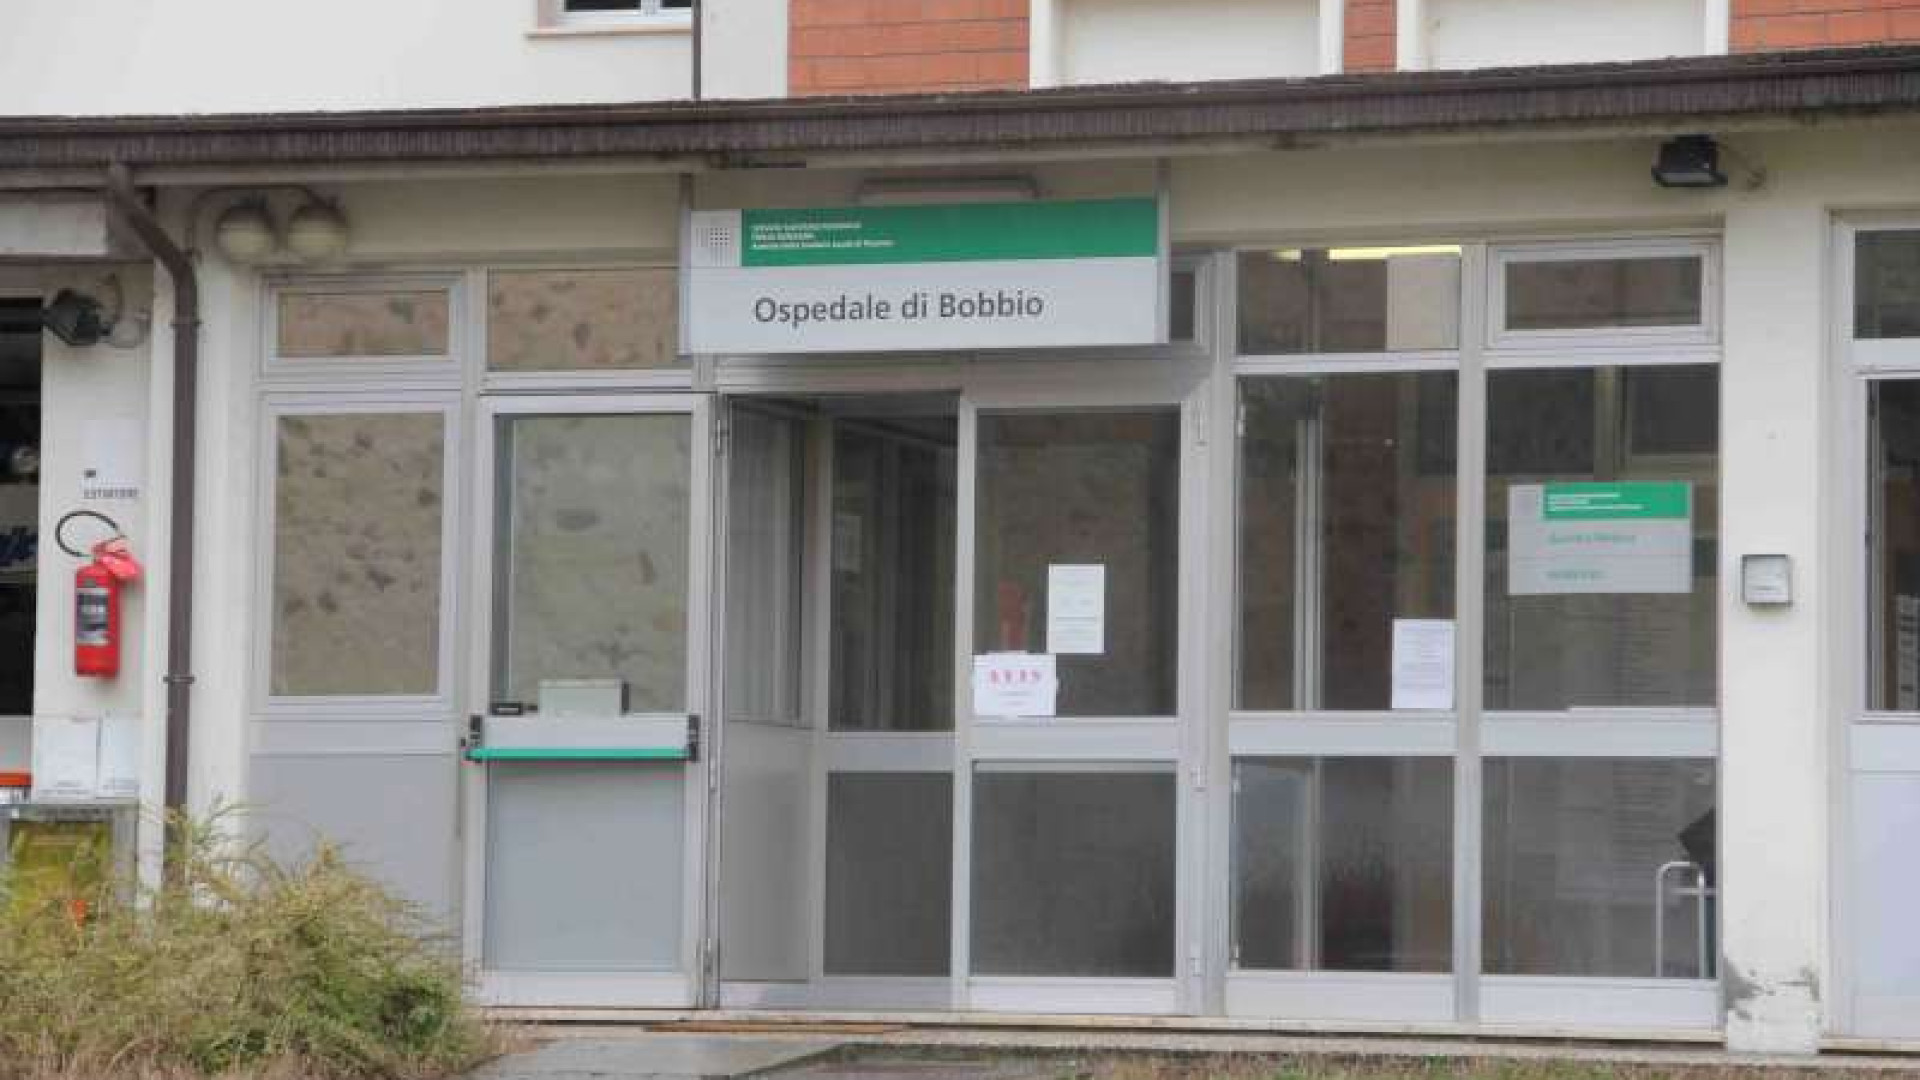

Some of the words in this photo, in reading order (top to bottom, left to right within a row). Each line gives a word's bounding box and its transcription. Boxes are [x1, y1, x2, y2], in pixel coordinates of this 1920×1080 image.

[755, 293, 891, 328] Ospedale
[901, 292, 928, 319] di
[940, 289, 1044, 318] Bobbio
